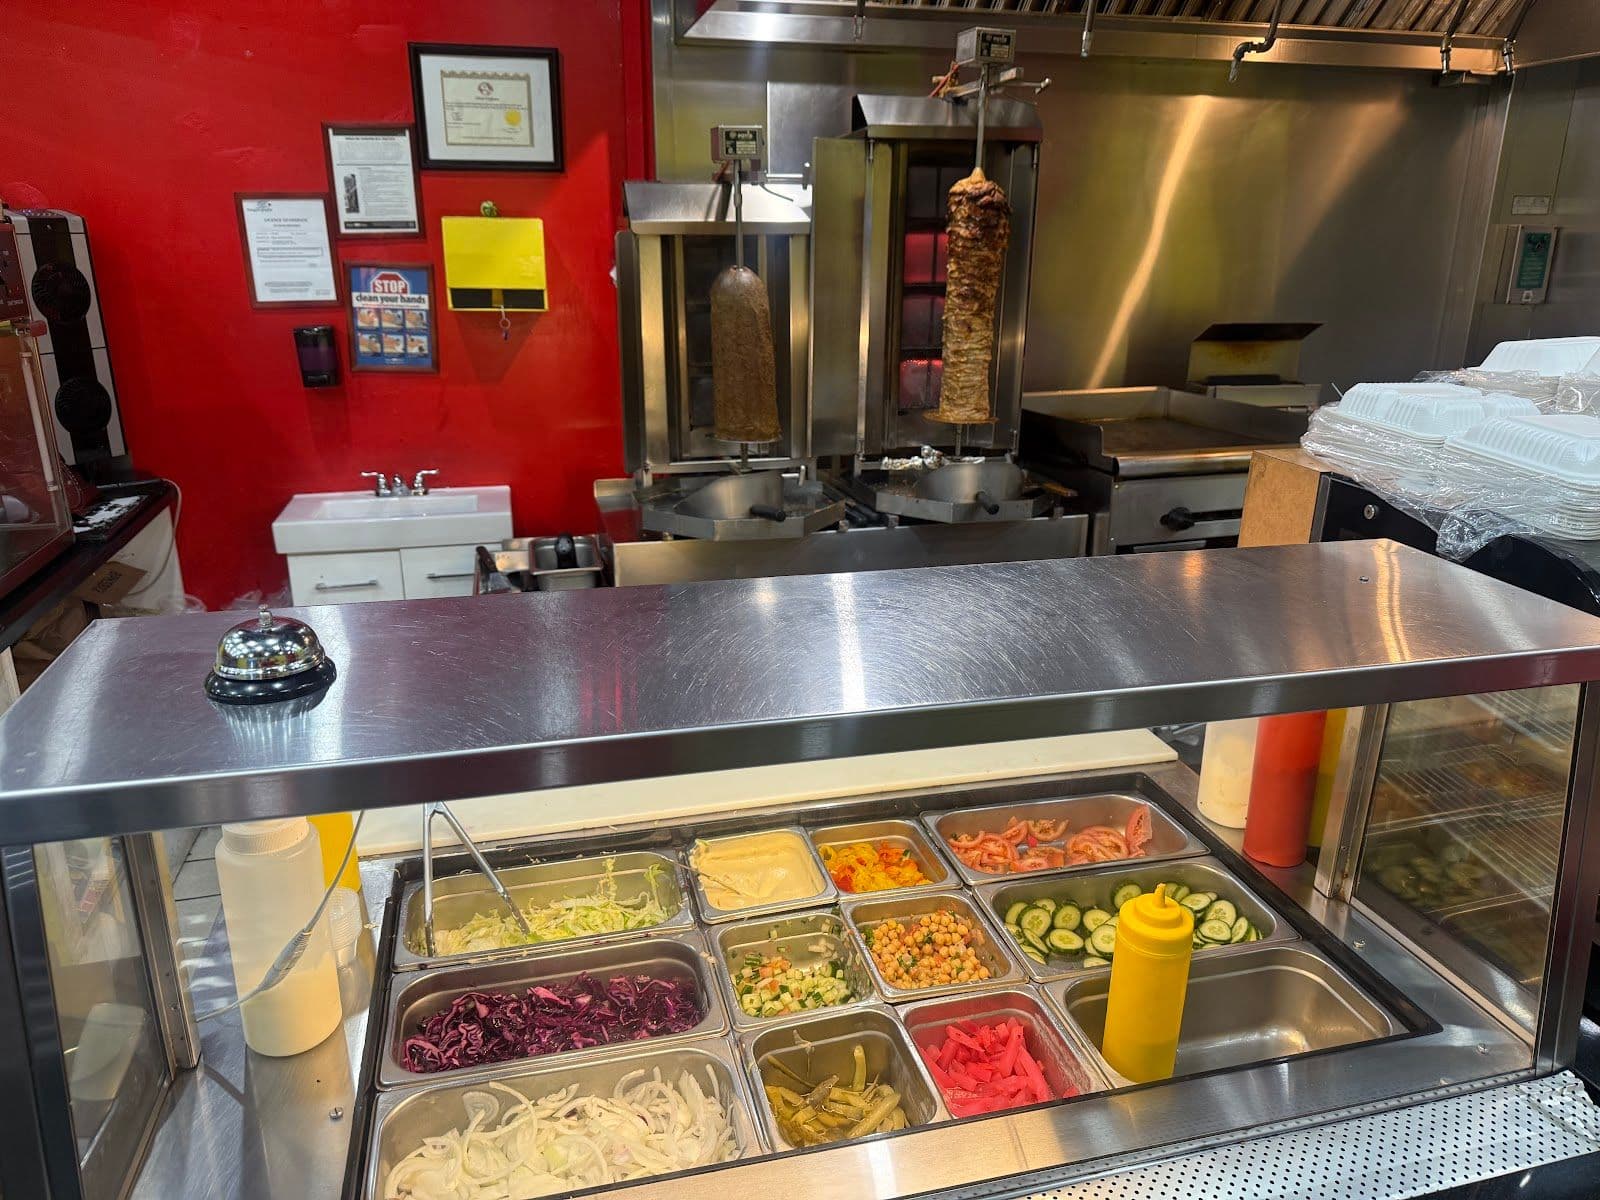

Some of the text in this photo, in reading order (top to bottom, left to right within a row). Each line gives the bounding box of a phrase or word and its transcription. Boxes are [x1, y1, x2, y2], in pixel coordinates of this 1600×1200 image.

[375, 280, 405, 293] STOP
[356, 294, 425, 304] clean your hands
